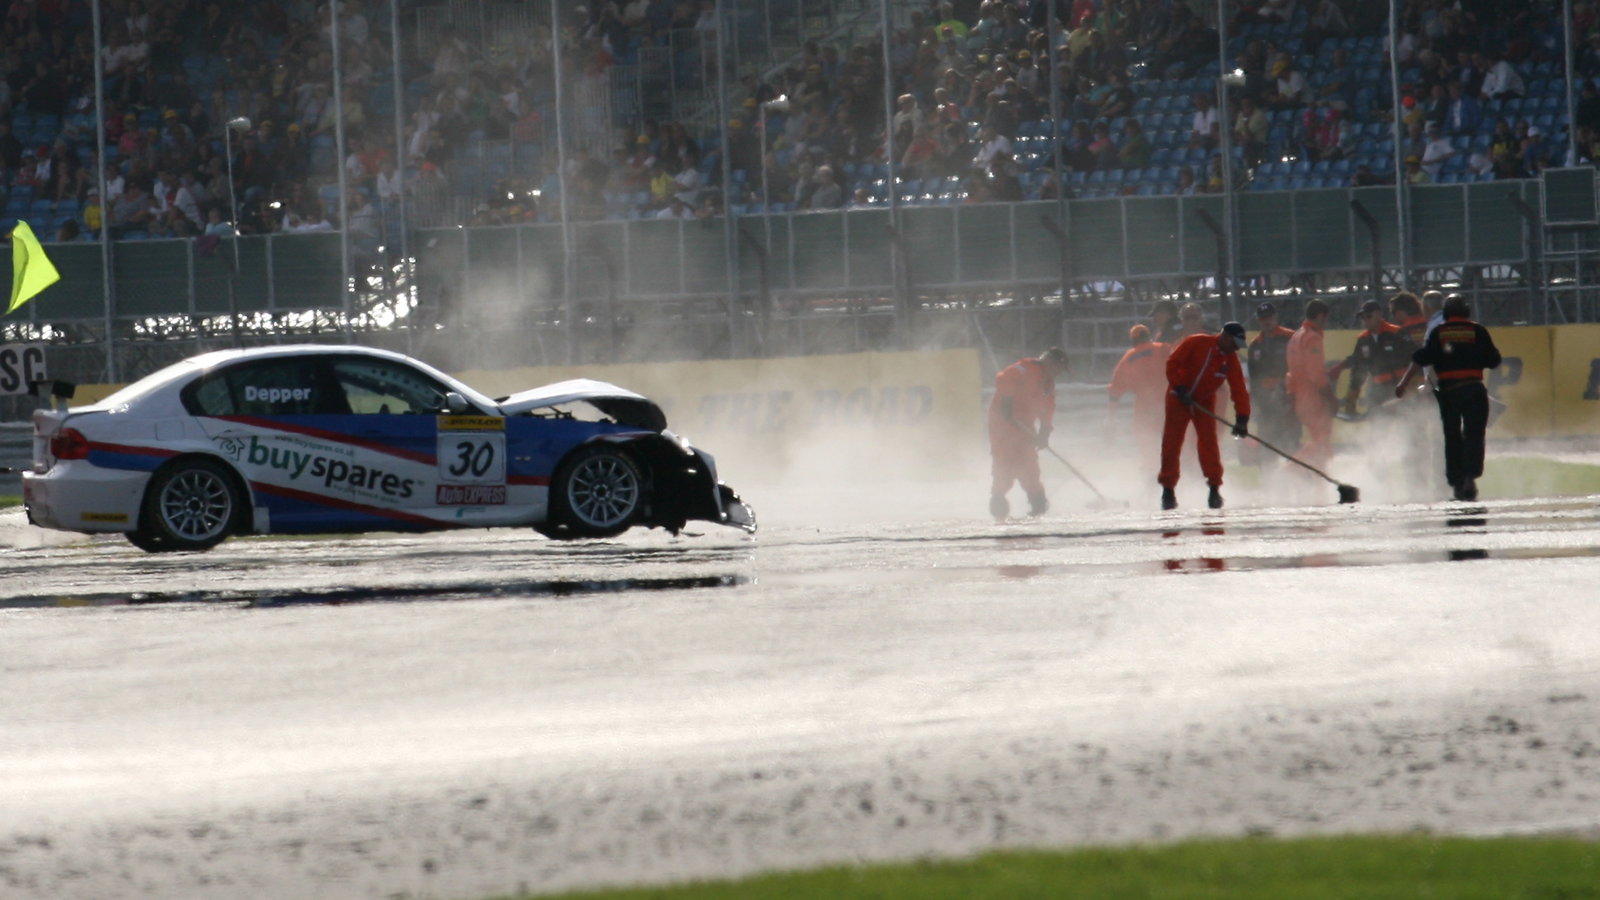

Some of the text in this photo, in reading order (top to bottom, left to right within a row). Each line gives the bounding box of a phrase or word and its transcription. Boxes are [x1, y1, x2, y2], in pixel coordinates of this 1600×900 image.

[0, 347, 43, 392] SC
[244, 385, 312, 403] Depper
[811, 384, 935, 426] ROAD
[248, 435, 415, 498] buyspares
[449, 441, 494, 477] 30
